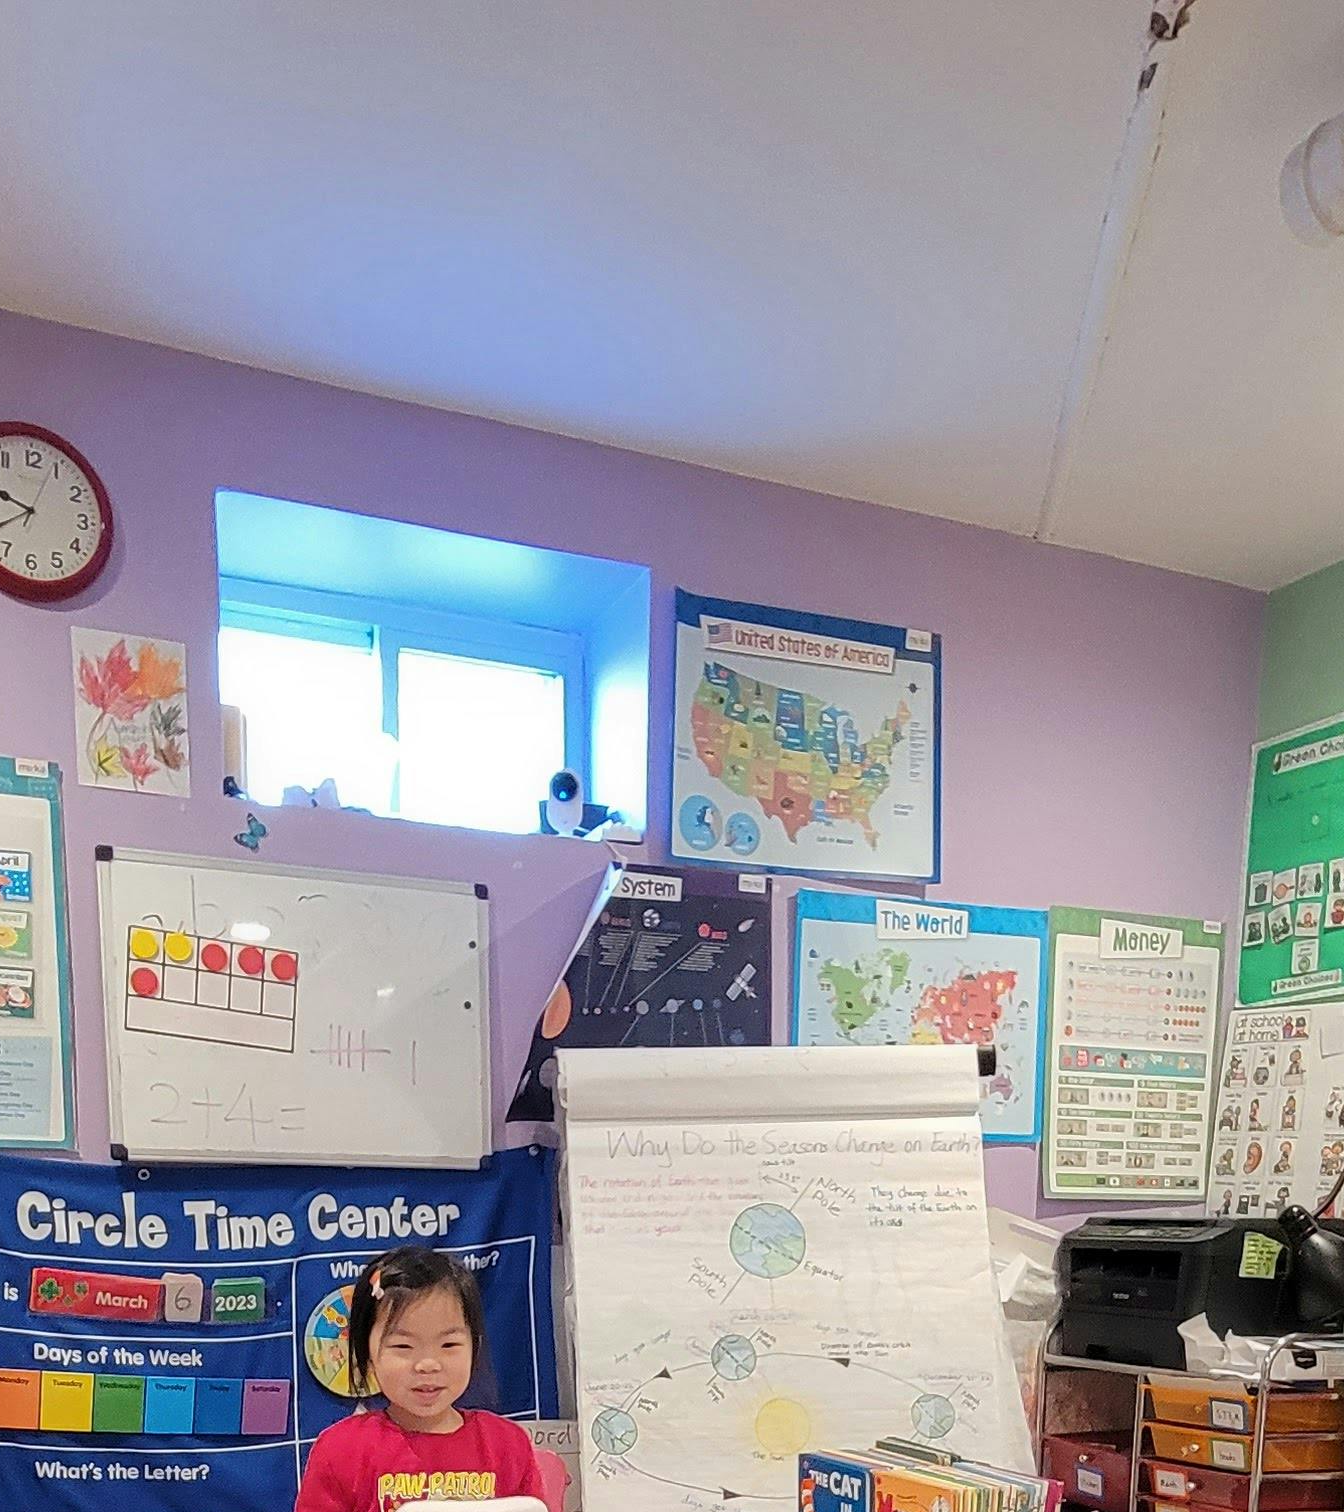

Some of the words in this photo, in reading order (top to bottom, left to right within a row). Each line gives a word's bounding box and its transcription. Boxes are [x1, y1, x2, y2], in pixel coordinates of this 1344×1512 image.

[1, 451, 10, 468] 11
[25, 450, 42, 468] 12
[55, 463, 58, 479] 1
[69, 486, 82, 503] 2
[77, 514, 88, 530] 3
[1, 541, 12, 557] 7
[69, 538, 81, 553] 4
[25, 554, 37, 570] 6
[51, 552, 63, 568] 5
[735, 628, 774, 650] United
[778, 634, 821, 657] States
[824, 644, 838, 658] of
[843, 649, 889, 667] America
[1282, 750, 1316, 767] Green
[621, 878, 675, 896] System
[880, 910, 910, 931] The
[915, 914, 964, 935] World
[1112, 927, 1171, 956] Money
[1279, 979, 1303, 989] Green
[1304, 973, 1334, 985] Choices
[1251, 1016, 1285, 1029] school
[1249, 1029, 1279, 1041] home
[607, 1130, 673, 1168] Why
[682, 1131, 715, 1156] Do
[724, 1130, 756, 1156] the
[836, 1129, 896, 1167] Change
[905, 1140, 920, 1153] on
[931, 1131, 980, 1157] Earth?
[816, 1177, 856, 1203] North
[870, 1187, 892, 1199] They
[934, 1185, 951, 1197] due
[955, 1187, 967, 1196] to
[812, 1190, 841, 1216] Pole
[866, 1204, 881, 1213] the
[907, 1203, 916, 1213] of
[920, 1203, 932, 1212] the
[935, 1203, 962, 1212] Earth
[16, 1191, 169, 1248] Circle
[184, 1199, 295, 1251] Time
[308, 1193, 460, 1241] Center
[691, 1257, 727, 1288] South
[803, 1261, 844, 1282] Equator
[4, 1283, 18, 1301] is
[96, 1292, 148, 1309] March
[175, 1288, 191, 1311] 6
[214, 1295, 257, 1312] 2023
[34, 1343, 82, 1365] Days
[89, 1348, 107, 1365] of
[114, 1348, 144, 1365] the
[150, 1350, 202, 1366] Week
[53, 1379, 83, 1388] Tuesday
[155, 1383, 187, 1392] Thursday
[35, 1462, 102, 1480] What's
[108, 1463, 139, 1479] the
[145, 1464, 210, 1480] Letter?
[378, 1472, 426, 1498] PAW
[809, 1469, 829, 1488] THE
[829, 1472, 861, 1500] CAT
